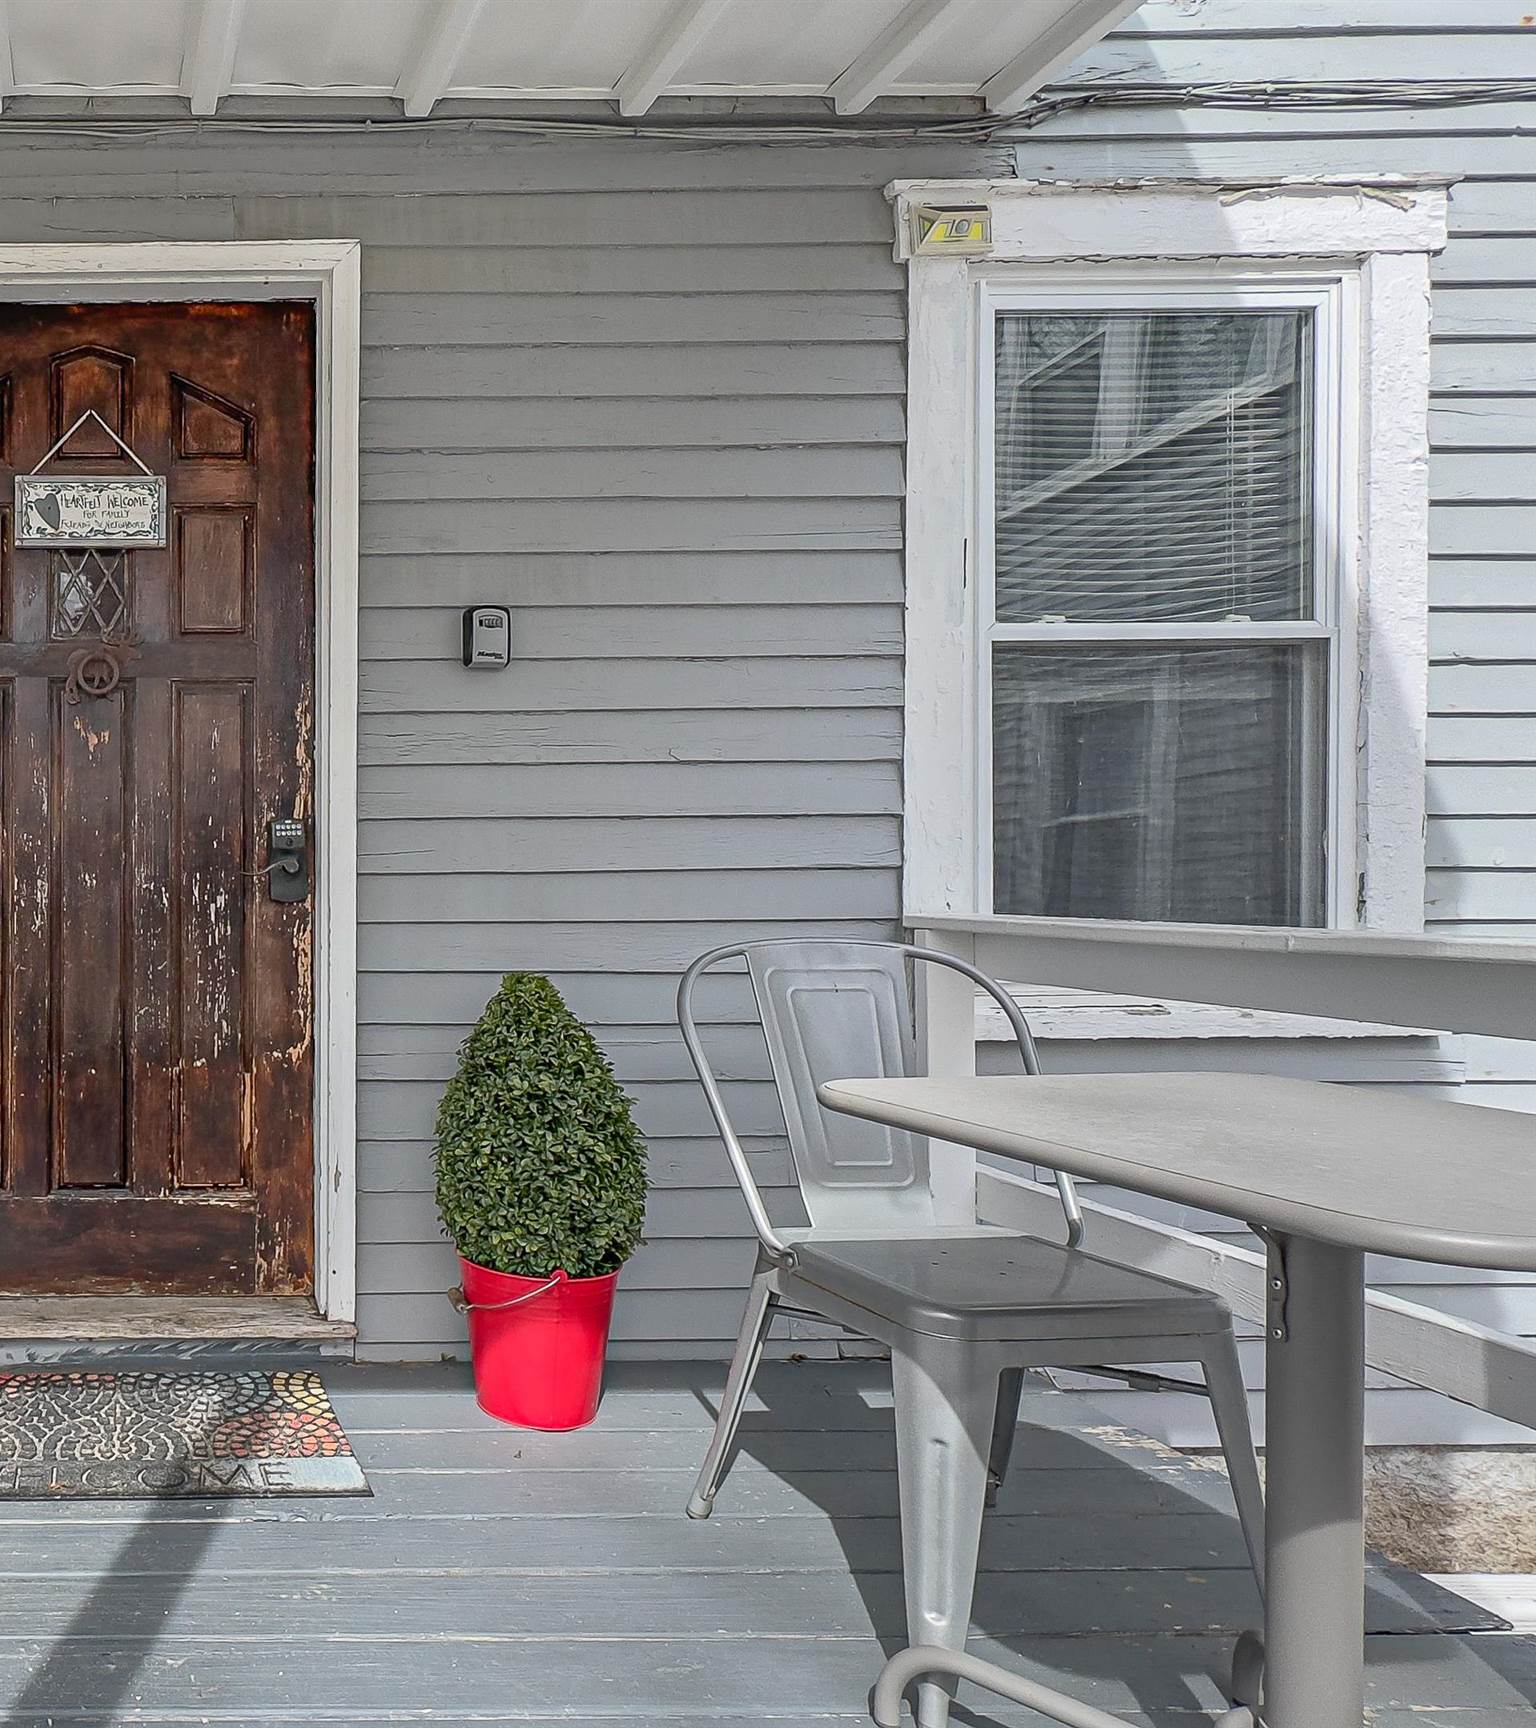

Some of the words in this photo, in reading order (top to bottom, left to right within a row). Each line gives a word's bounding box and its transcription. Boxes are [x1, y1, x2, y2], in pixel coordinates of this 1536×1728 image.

[60, 493, 101, 509] HEARTFELT
[107, 493, 149, 509] WELCOME
[83, 510, 97, 519] FOR
[102, 510, 129, 519] FAMILY
